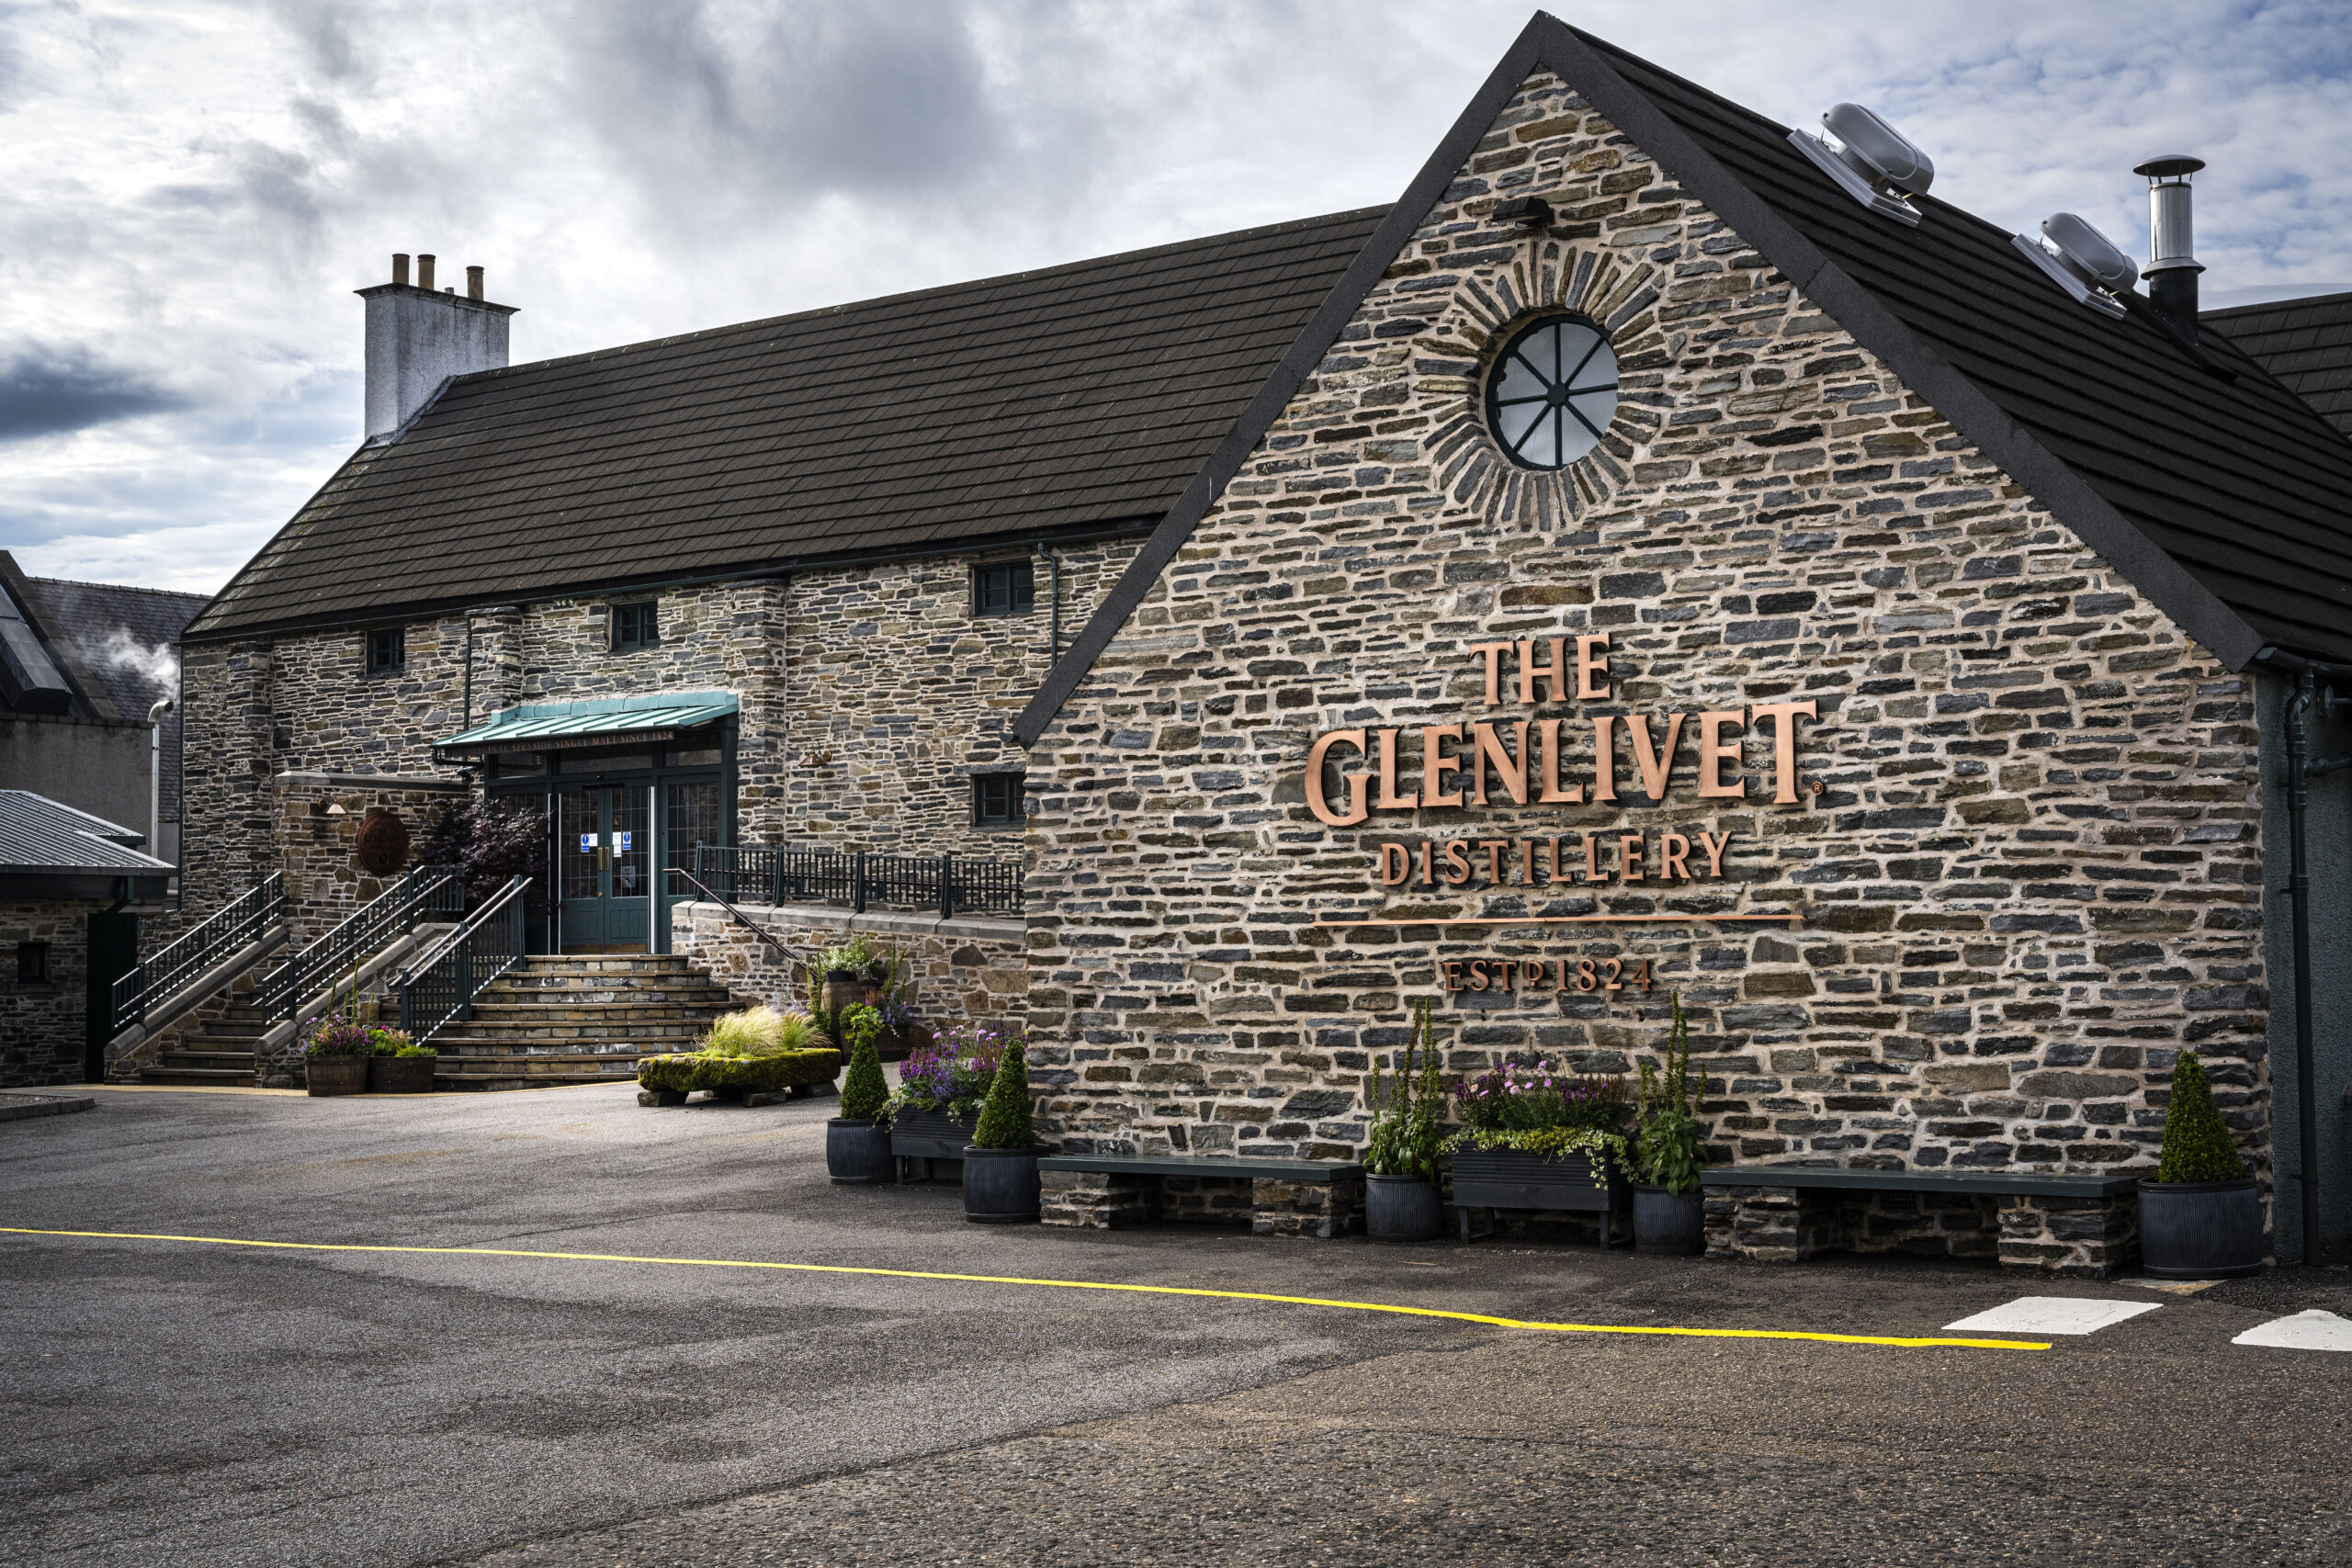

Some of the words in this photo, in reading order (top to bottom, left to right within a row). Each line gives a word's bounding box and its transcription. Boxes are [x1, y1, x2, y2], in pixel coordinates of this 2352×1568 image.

[1470, 632, 1611, 705] THE
[512, 740, 551, 752] SPEYSIDE
[556, 737, 588, 749] SINGLE
[592, 735, 616, 746] MALT
[620, 733, 648, 744] SINCE
[652, 730, 673, 741] 1824
[1305, 700, 1817, 826] GLENLIVET
[1381, 830, 1732, 886] DISTILLERY
[1556, 958, 1652, 991] 1824
